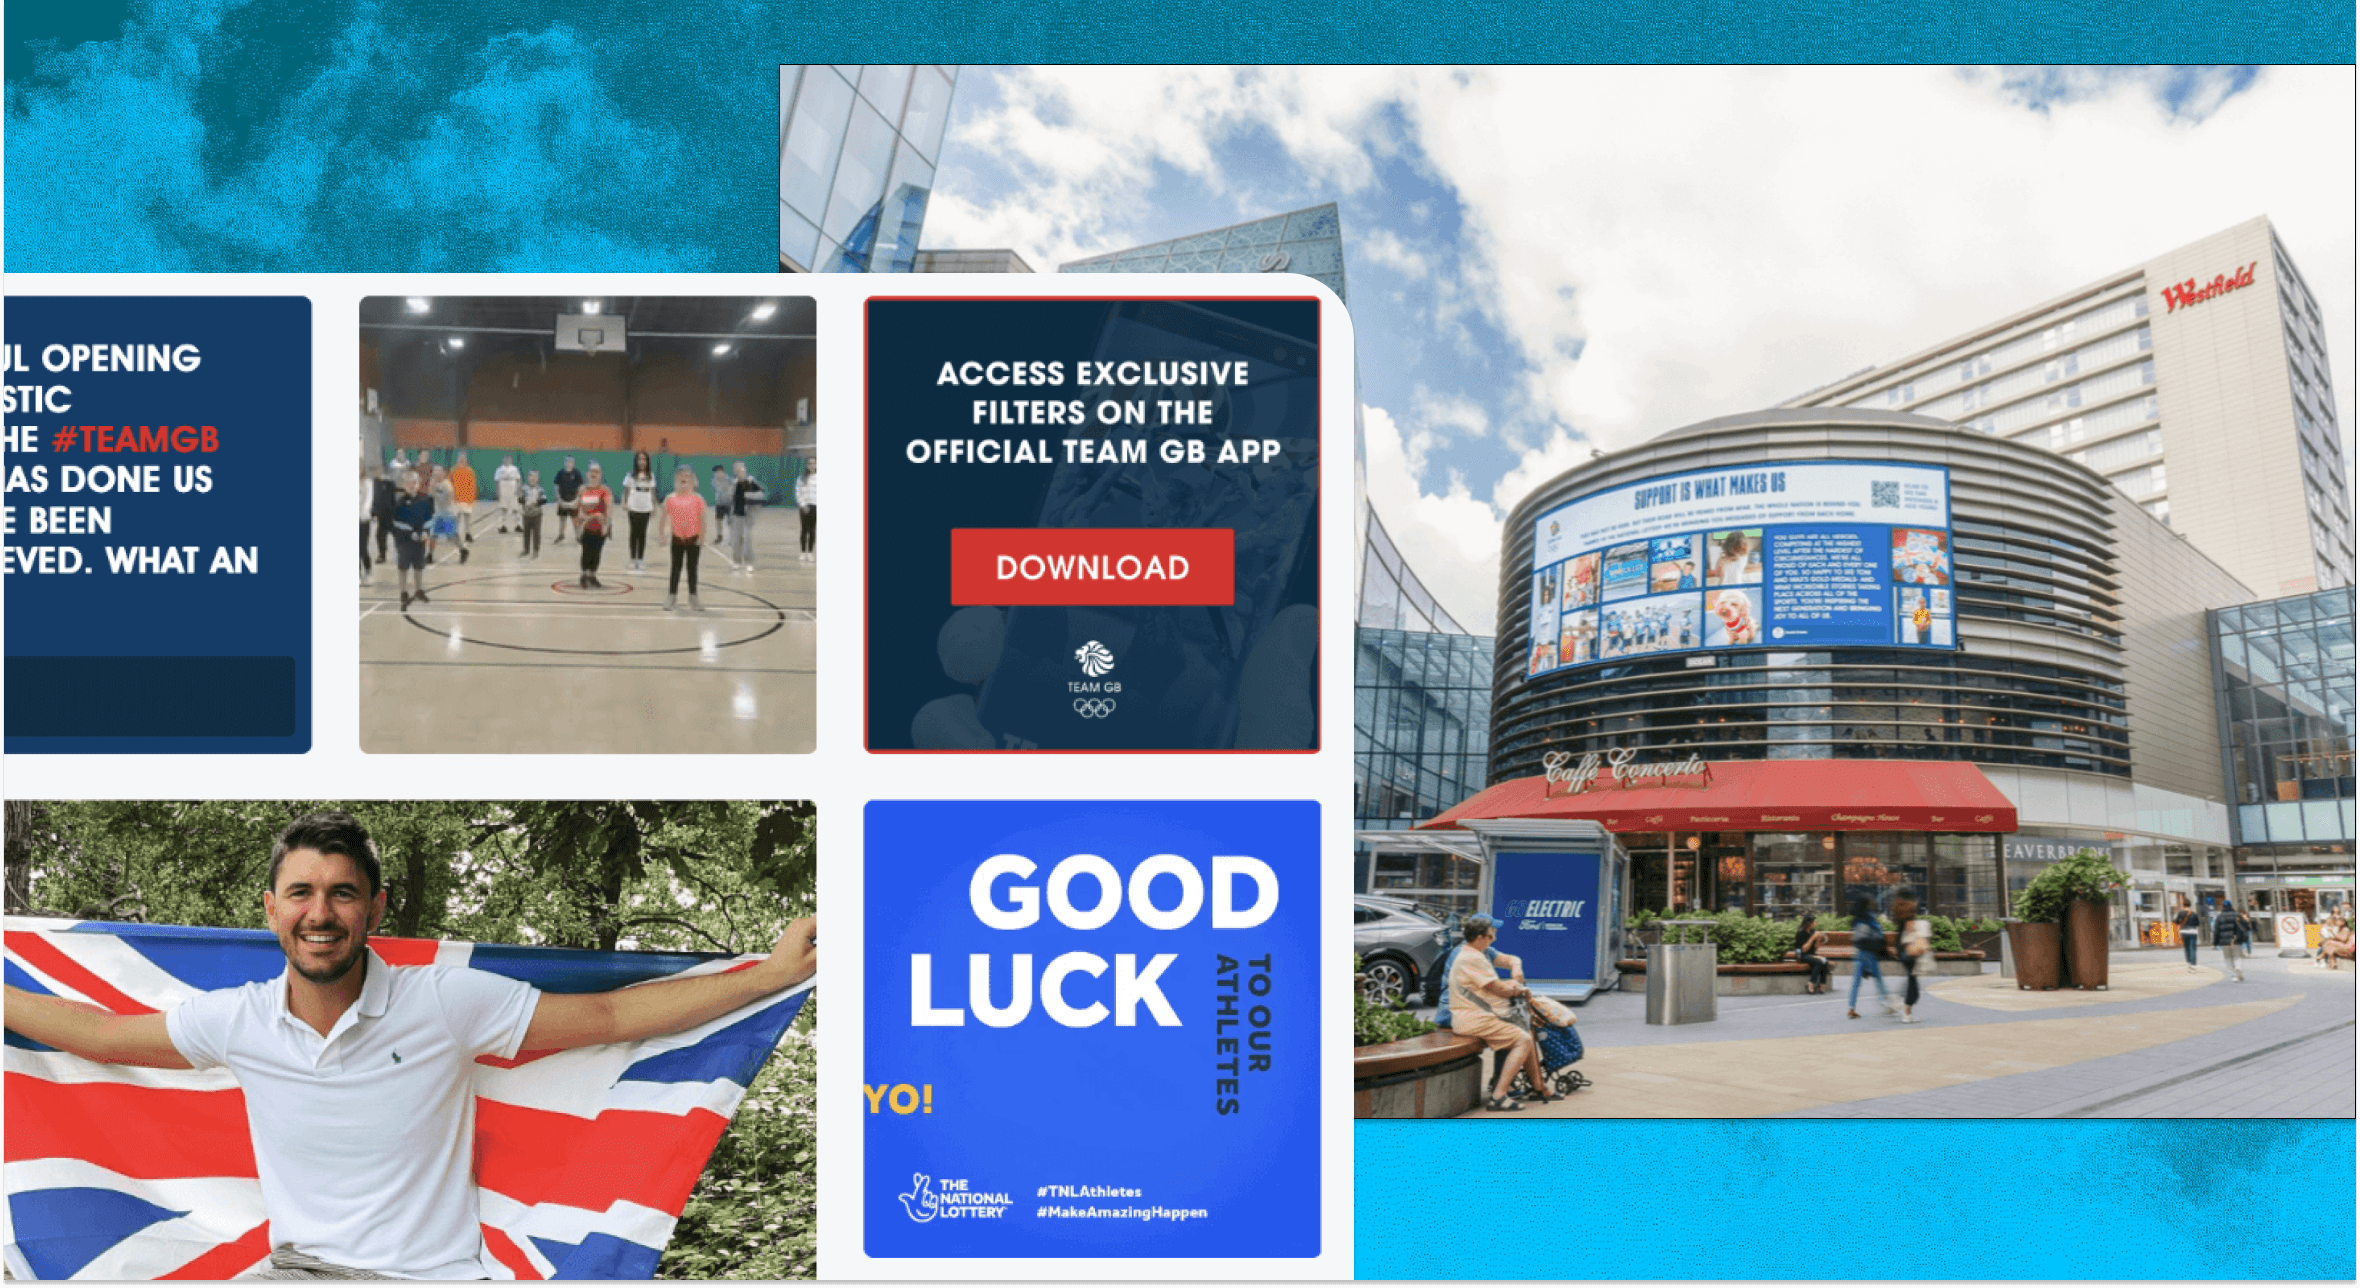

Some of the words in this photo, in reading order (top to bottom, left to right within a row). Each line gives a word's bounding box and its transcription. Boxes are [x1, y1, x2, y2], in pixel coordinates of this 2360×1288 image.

[2161, 261, 2257, 314] Westfield
[42, 343, 202, 373] OPENING
[936, 361, 1065, 386] ACCESS
[1076, 361, 1249, 386] EXCLUSIVE
[4, 385, 72, 414] STIC
[972, 400, 1085, 425] FILTERS
[1097, 400, 1146, 425] ON
[1157, 400, 1213, 425] THE
[52, 425, 219, 453] #TEAMGB
[906, 439, 1053, 464] OFFICIAL
[1063, 439, 1147, 464] TEAM
[1159, 439, 1205, 464] GB
[1217, 439, 1281, 464] APP
[4, 465, 48, 493] AS
[61, 465, 160, 493] DONE
[173, 465, 213, 493] US
[1634, 482, 1677, 510] SUPPORT
[1680, 481, 1690, 502] IS
[1694, 476, 1728, 499] WHAT
[1729, 473, 1767, 495] MAKES
[1771, 472, 1786, 492] US
[30, 506, 112, 534] BEEN
[105, 546, 200, 574] WHAT
[209, 546, 258, 574] AN
[996, 554, 1190, 580] DOWNLOAD
[1067, 682, 1101, 693] TEAM
[1103, 682, 1122, 693] GB
[1608, 747, 1706, 780] Concerto
[969, 853, 1280, 930] GOOD
[1524, 899, 1586, 918] ELECTRIC
[1248, 953, 1272, 997] TO
[911, 950, 1183, 1029] LUCK
[1216, 953, 1240, 1116] ATHLETES
[1248, 1004, 1272, 1072] OUR
[863, 1083, 933, 1115] YO!
[940, 1179, 969, 1191] THE
[940, 1193, 1014, 1204] NATIONAL
[1037, 1184, 1143, 1198] #TNLAthletes
[940, 1206, 1006, 1218] LOTTERY
[1037, 1205, 1209, 1221] #MakeAmazingHappen
